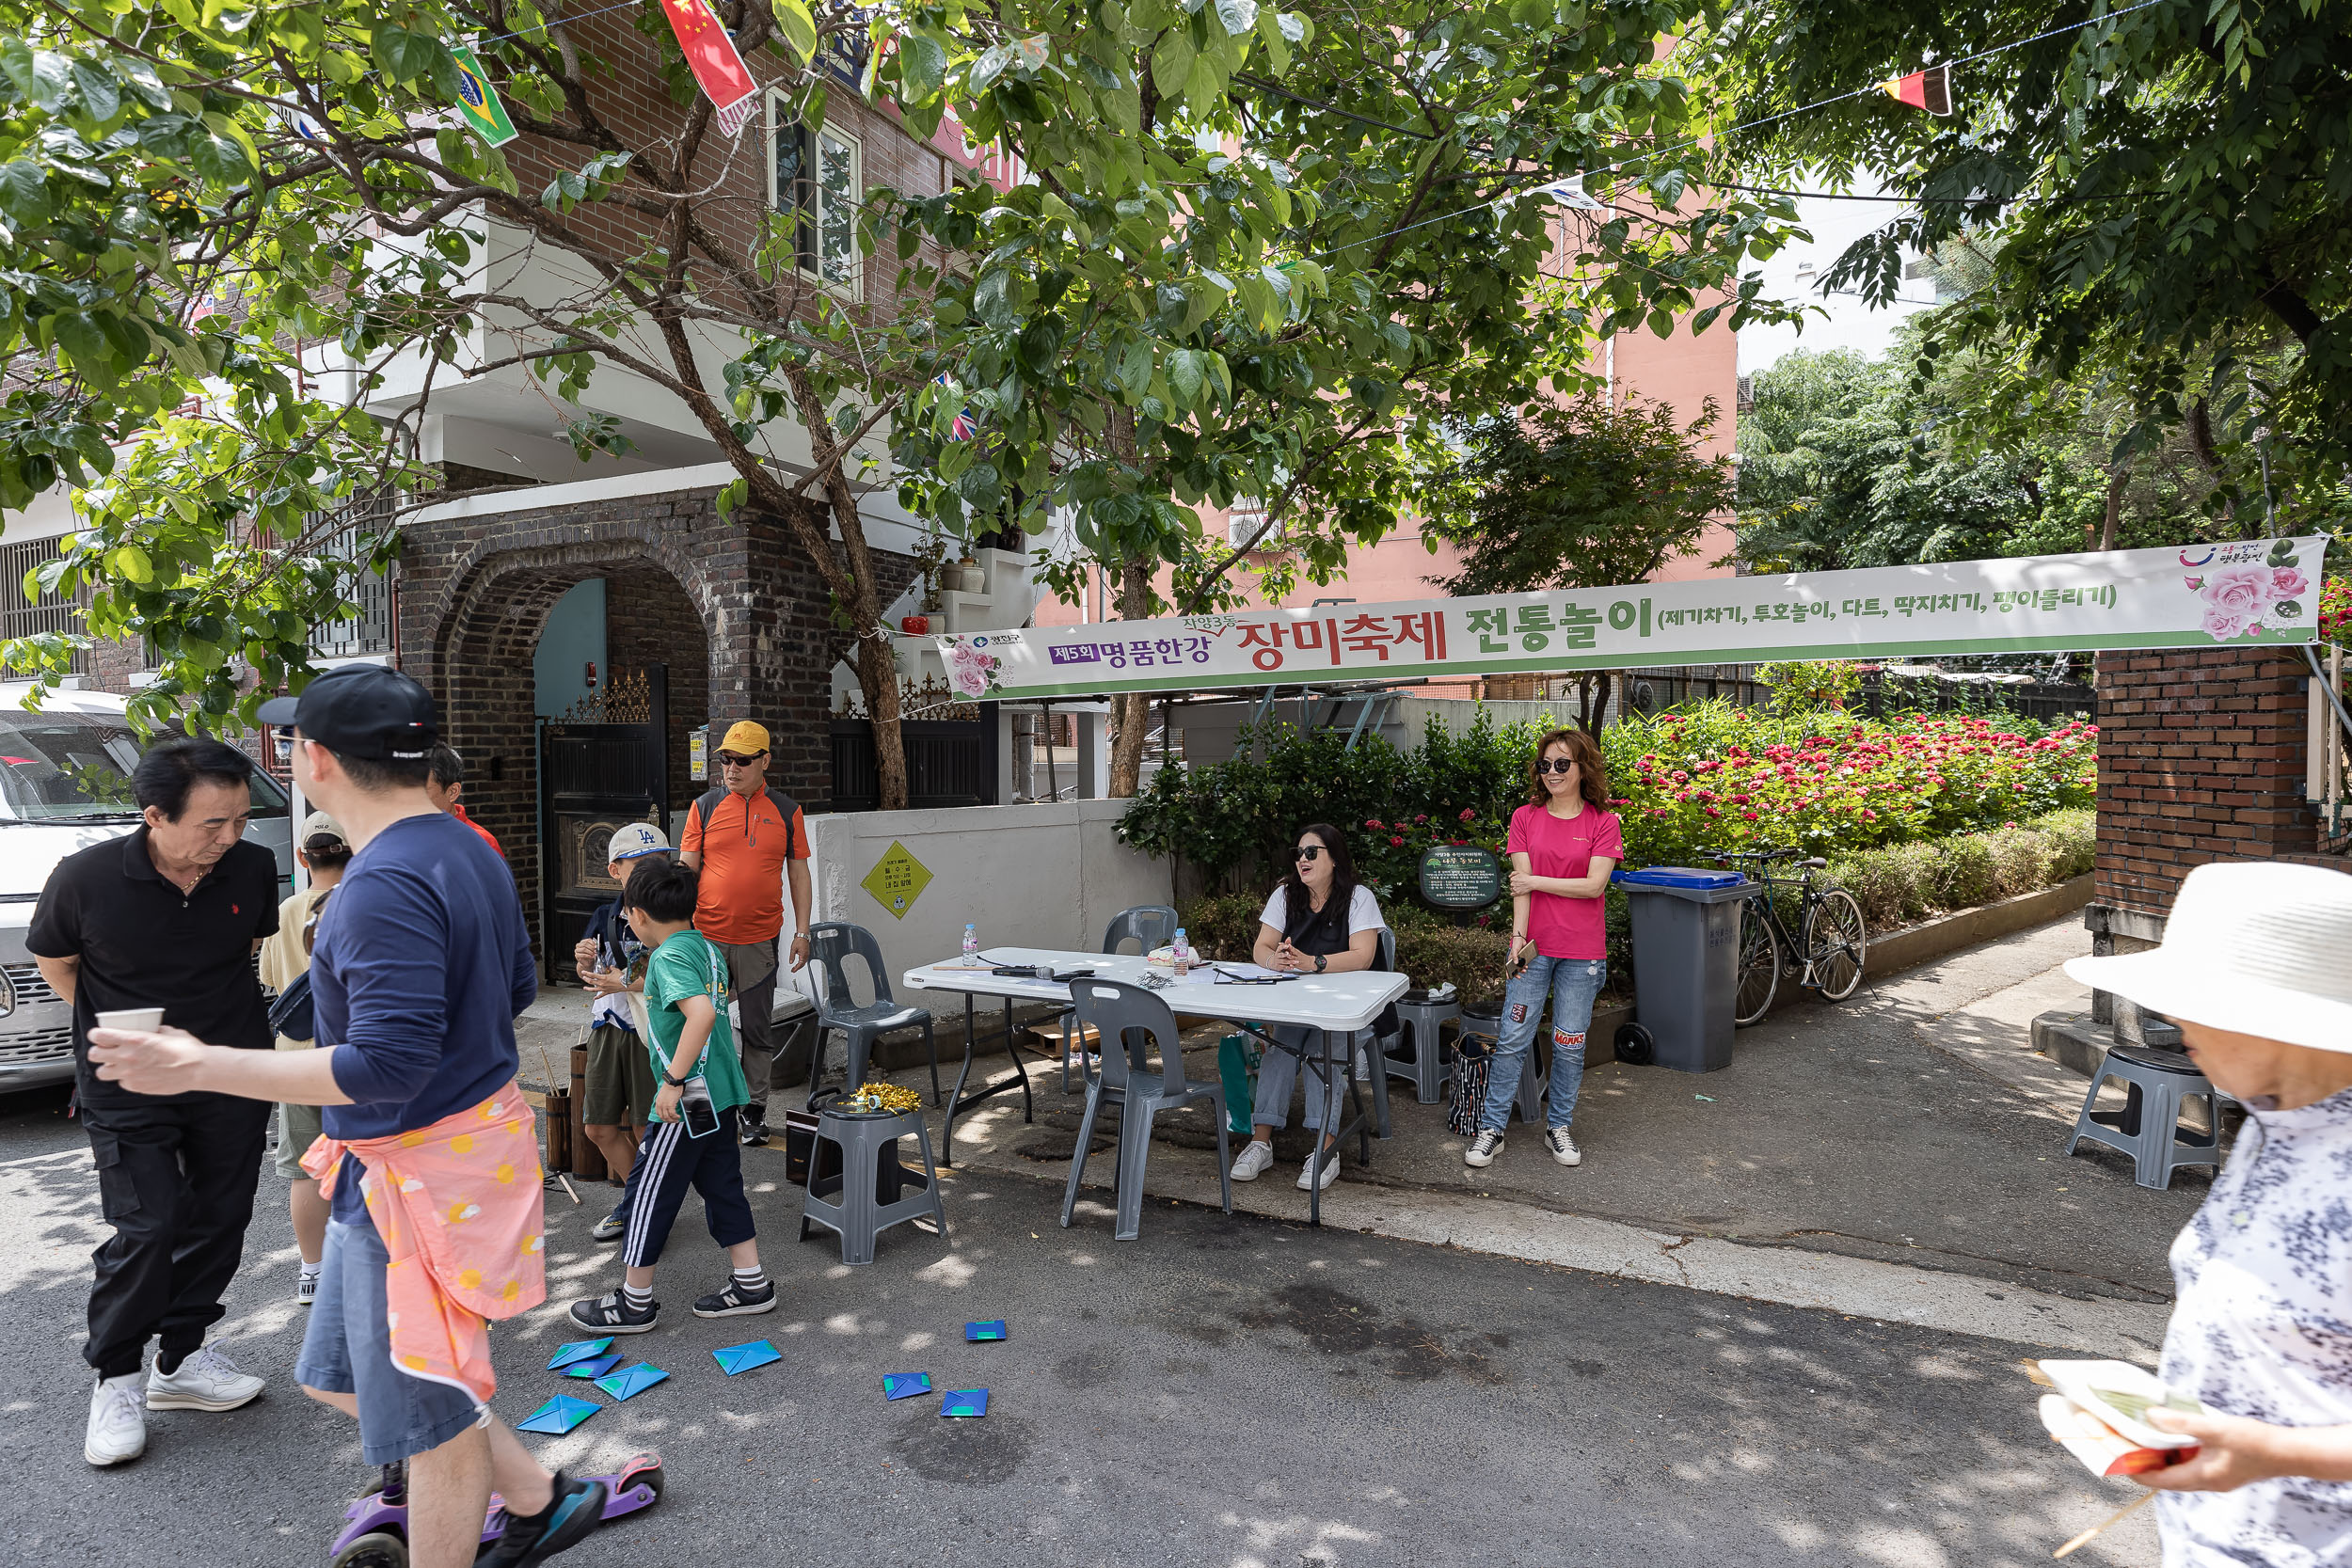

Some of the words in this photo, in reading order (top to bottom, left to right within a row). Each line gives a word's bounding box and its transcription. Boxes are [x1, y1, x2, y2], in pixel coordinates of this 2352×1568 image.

[2220, 552, 2263, 563] 행복광진
[1054, 645, 1094, 661] 제5회
[1099, 636, 1212, 669] 명품한강
[1236, 610, 1448, 672] 장미축제
[1466, 597, 1653, 654] 전통놀이
[1658, 606, 1748, 631] (제기차기,
[1752, 600, 1837, 624] 투호놀이,
[1841, 597, 1889, 619] 다트,
[1893, 593, 1988, 618] 딱지치기,
[1993, 584, 2118, 613] 팽이돌리기)
[1183, 614, 1236, 629] 자양3동
[637, 829, 655, 845] LA
